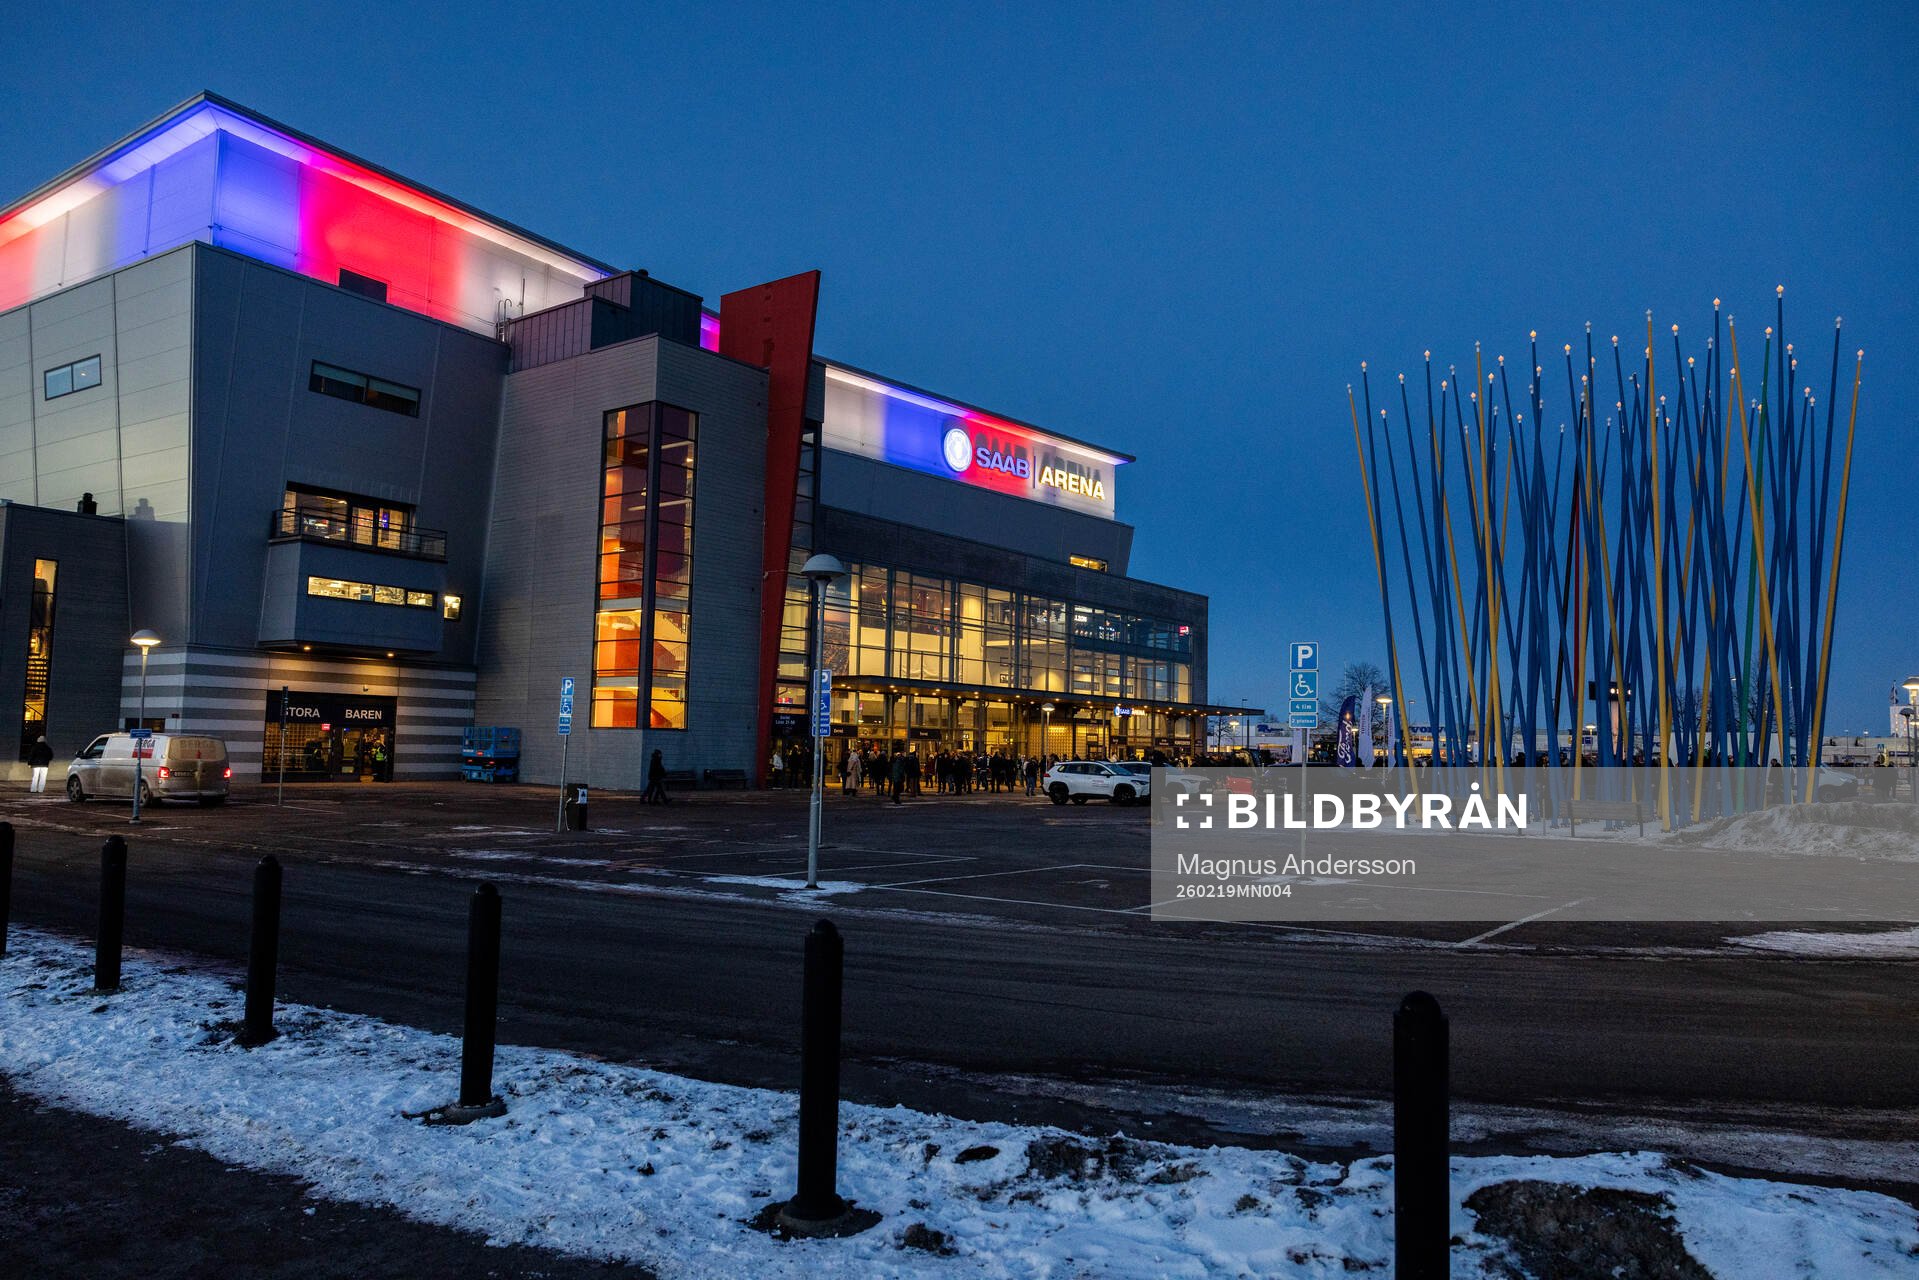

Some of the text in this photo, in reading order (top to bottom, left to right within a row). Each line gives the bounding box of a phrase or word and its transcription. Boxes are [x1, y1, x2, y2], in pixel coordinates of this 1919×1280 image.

[976, 447, 1105, 500] SAAB ARENA
[1298, 645, 1313, 668] P
[565, 680, 572, 694] P
[345, 709, 382, 720] BAREN
